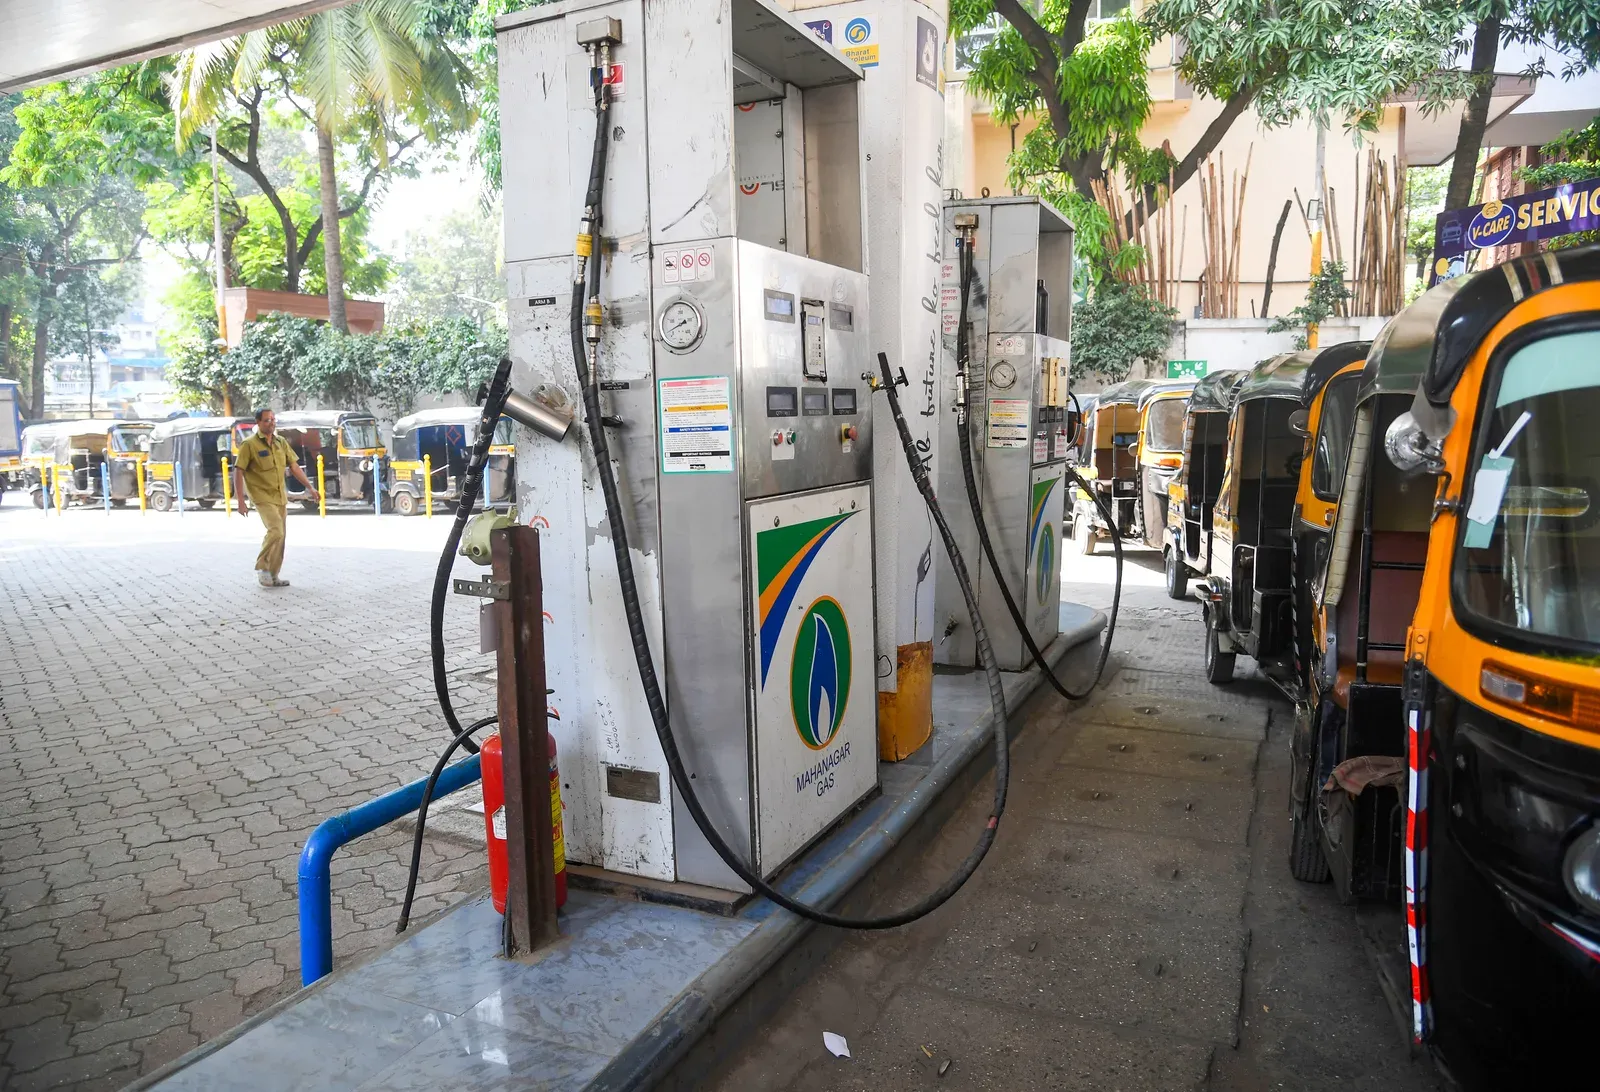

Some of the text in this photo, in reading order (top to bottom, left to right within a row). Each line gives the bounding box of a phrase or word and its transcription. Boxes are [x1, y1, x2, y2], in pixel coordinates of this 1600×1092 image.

[845, 49, 870, 57] Bharat
[1471, 214, 1511, 241] V-CARE
[921, 277, 940, 314] ko
[796, 742, 850, 793] MAHANAGAR
[816, 772, 834, 797] GAS
